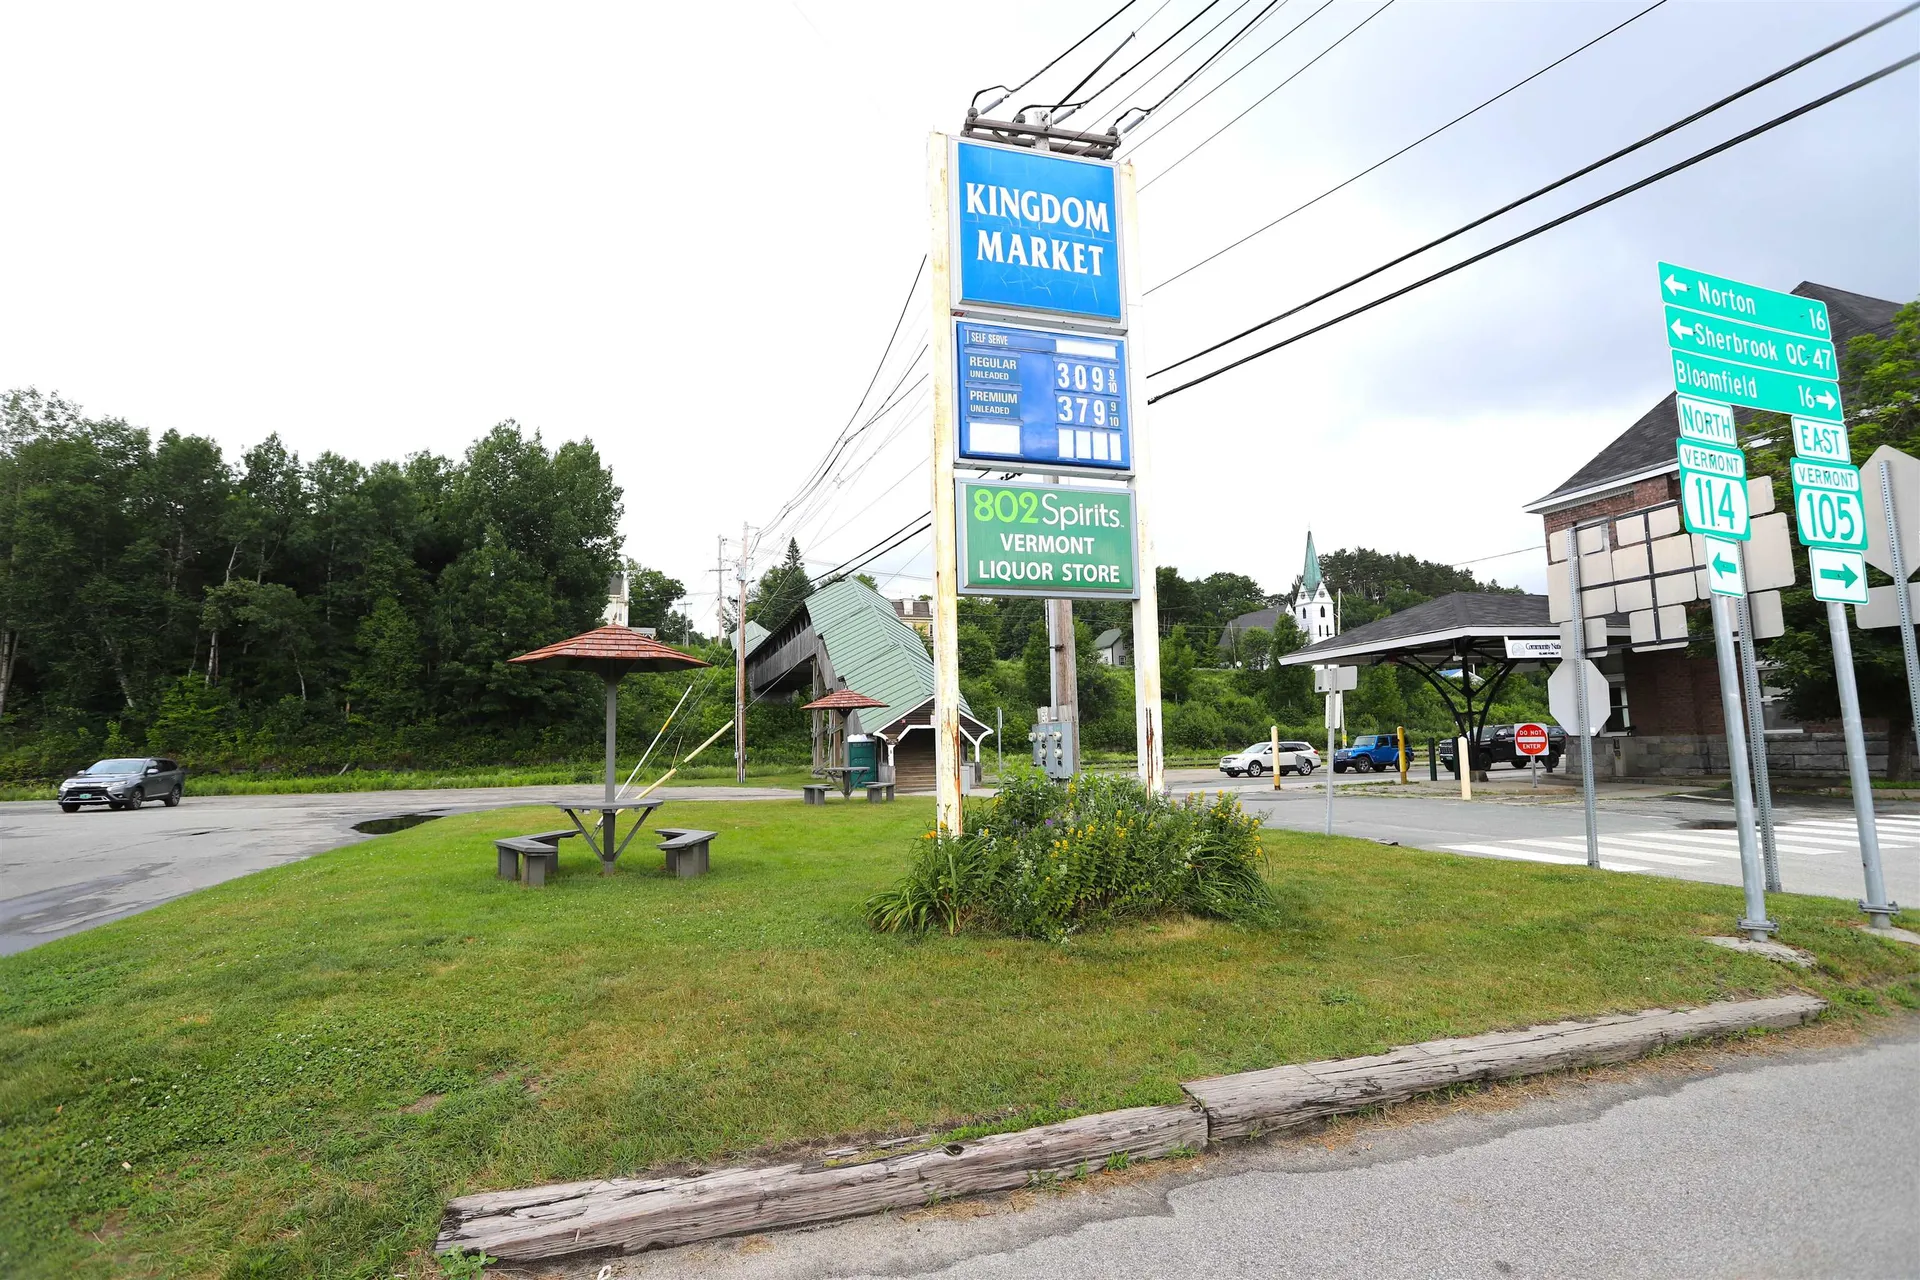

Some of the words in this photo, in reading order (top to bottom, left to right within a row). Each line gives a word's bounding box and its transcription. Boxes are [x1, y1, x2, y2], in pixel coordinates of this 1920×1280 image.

[966, 183, 1110, 233] KINGDOM
[977, 229, 1103, 276] MARKET
[1698, 280, 1756, 315] Norton
[1809, 308, 1826, 331] 16
[971, 332, 986, 344] SELF
[988, 333, 1008, 346] SERVE
[1694, 323, 1778, 361] Sherbrook
[1813, 349, 1832, 371] 47
[969, 356, 1017, 370] REGULAR
[970, 369, 1009, 381] UNLEADED
[1057, 362, 1104, 392] 309
[970, 390, 1018, 404] PREMIUM
[1676, 359, 1757, 399] Bloomfield
[1798, 385, 1815, 409] 16
[970, 404, 1010, 415] UNLEADED
[1057, 396, 1106, 426] 379
[1682, 403, 1732, 439] NORTH
[1801, 425, 1840, 455] EAST
[1684, 448, 1739, 474] VERMONT
[1798, 465, 1854, 488] VERMONT
[974, 489, 1039, 524] 802
[1695, 477, 1735, 530] 114
[1807, 493, 1854, 541] 105
[1000, 533, 1095, 555] VERMONT
[979, 560, 1053, 582] LIQUOR
[1062, 563, 1120, 583] STORE
